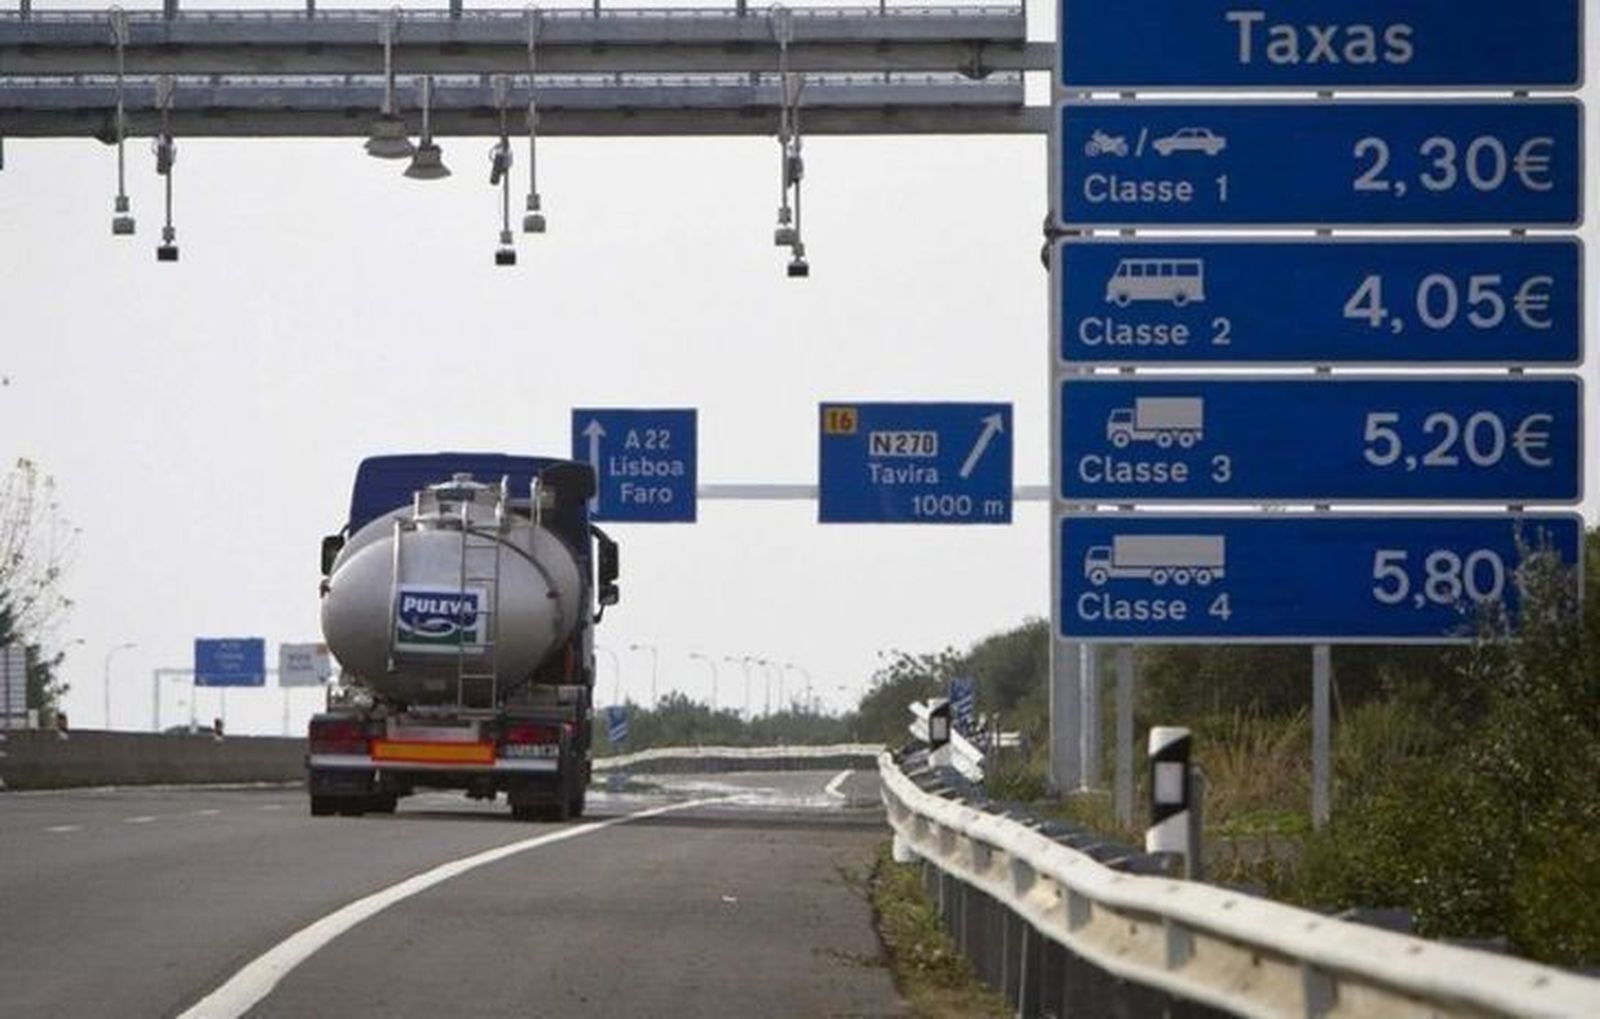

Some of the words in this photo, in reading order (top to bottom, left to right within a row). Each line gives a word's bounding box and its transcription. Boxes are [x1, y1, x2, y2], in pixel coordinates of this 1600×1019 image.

[1226, 10, 1413, 65] Taxas
[1353, 136, 1554, 197] 2,30€
[1083, 173, 1194, 202] Classe
[1215, 174, 1228, 202] 1
[1343, 274, 1553, 334] 4,05€
[1078, 316, 1190, 346] Classe
[1211, 317, 1231, 345] 2
[828, 411, 852, 431] 16
[1363, 411, 1553, 471] 5,20€
[609, 456, 684, 477] Lisboa
[868, 462, 939, 484] Tavira
[1078, 454, 1189, 483] Classe
[1211, 454, 1232, 483] 3
[620, 482, 673, 504] Faro
[913, 494, 972, 516] 1000
[984, 500, 1005, 516] m
[1077, 591, 1187, 621] Classe
[1208, 592, 1232, 621] 4
